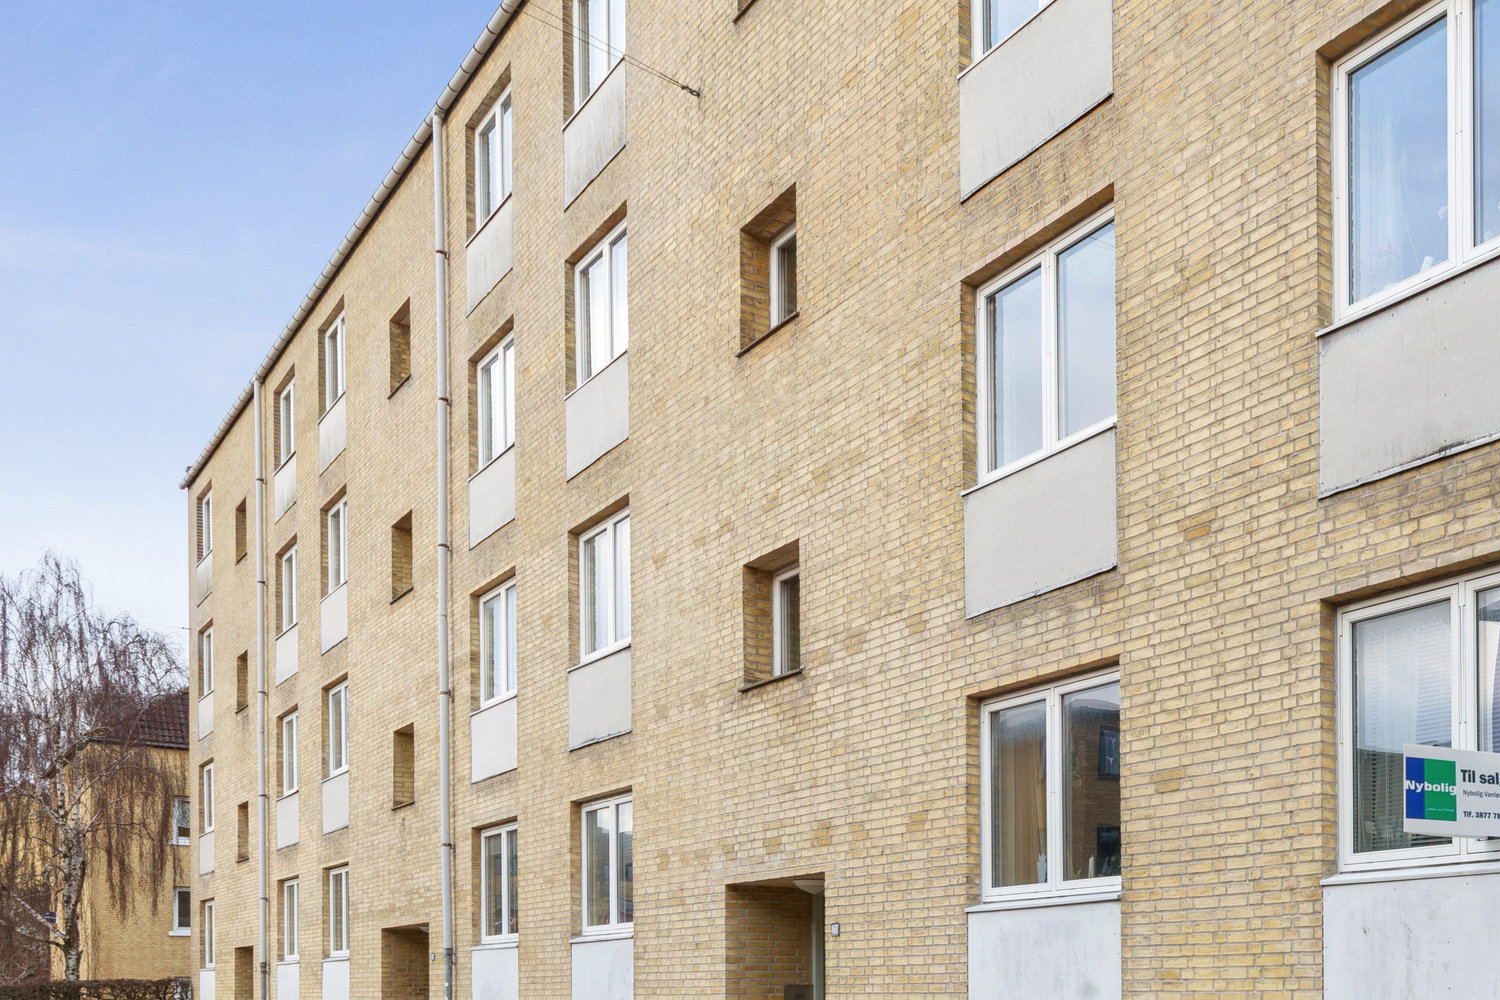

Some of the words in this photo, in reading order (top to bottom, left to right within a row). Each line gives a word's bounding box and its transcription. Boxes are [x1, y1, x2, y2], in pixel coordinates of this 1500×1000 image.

[1460, 769, 1476, 783] Til
[1405, 779, 1457, 796] Nybolig
[1462, 789, 1483, 798] Nybolig
[1463, 810, 1474, 818] Tlf.
[1475, 811, 1491, 819] 3877
